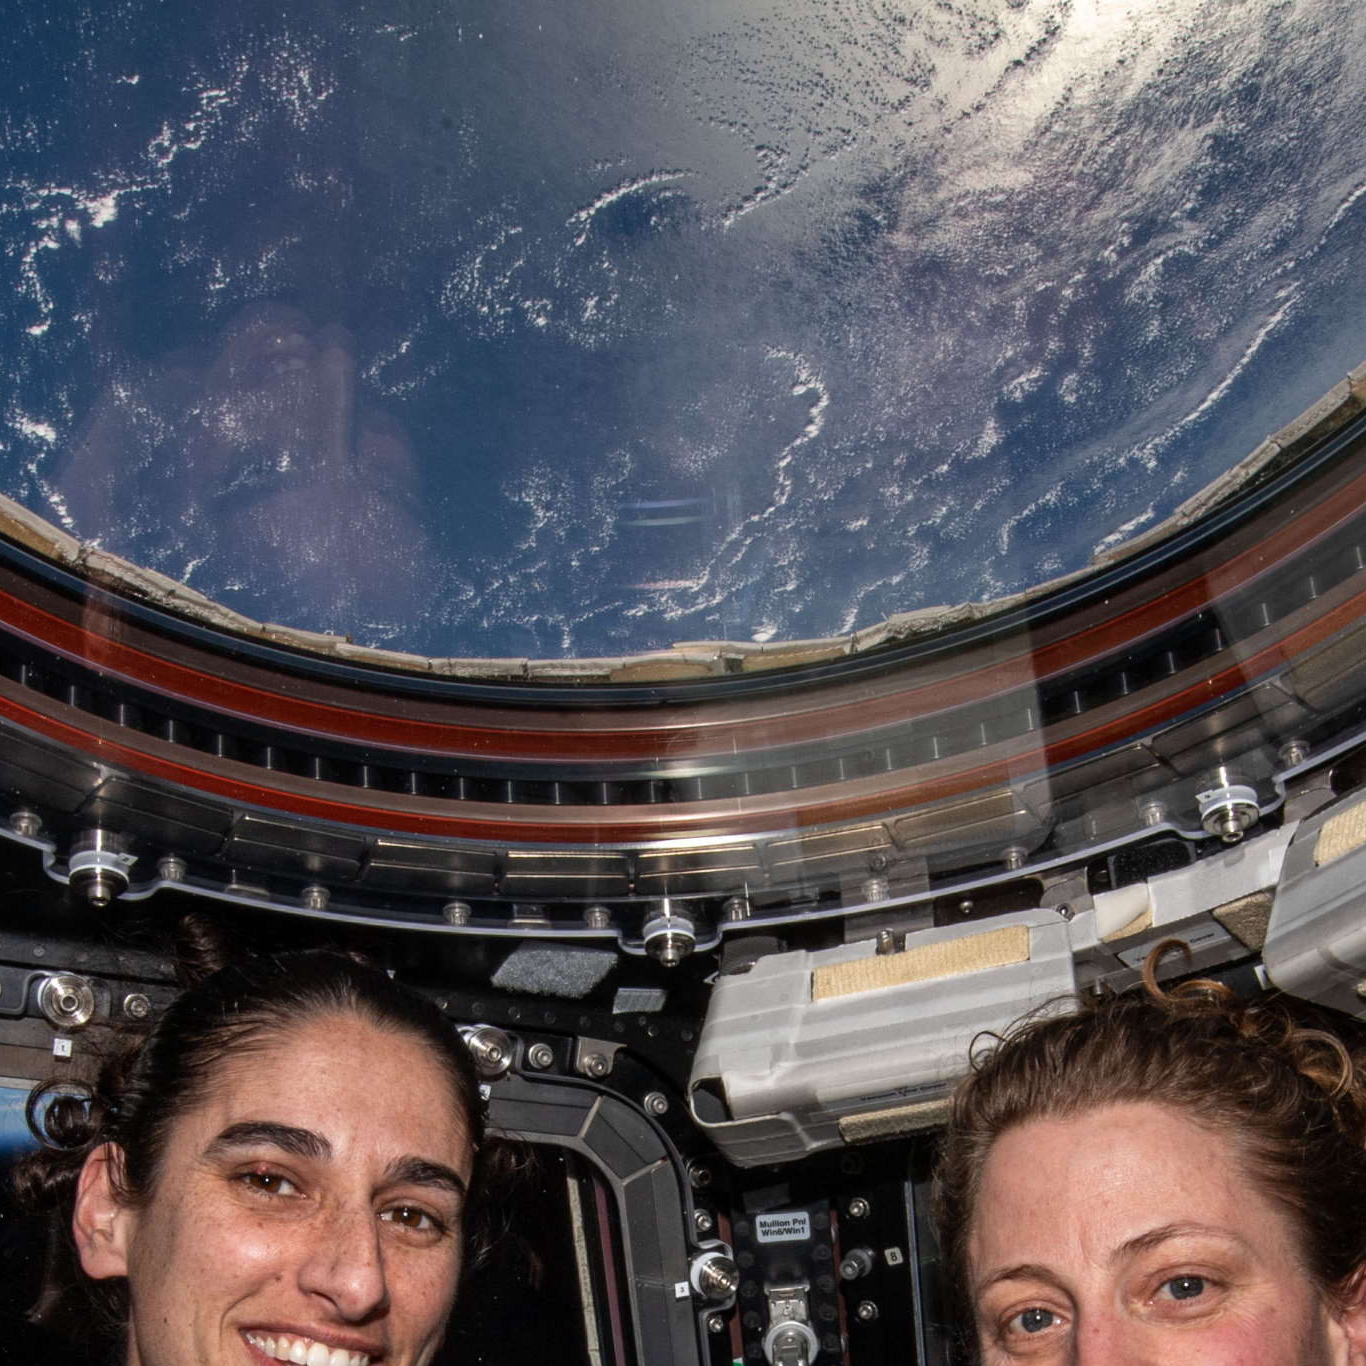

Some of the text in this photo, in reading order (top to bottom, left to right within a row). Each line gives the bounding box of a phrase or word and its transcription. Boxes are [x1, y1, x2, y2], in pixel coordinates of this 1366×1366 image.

[759, 1218, 807, 1229] Mullion Pnl
[761, 1226, 805, 1237] Win6/Win1
[890, 1251, 898, 1261] 8
